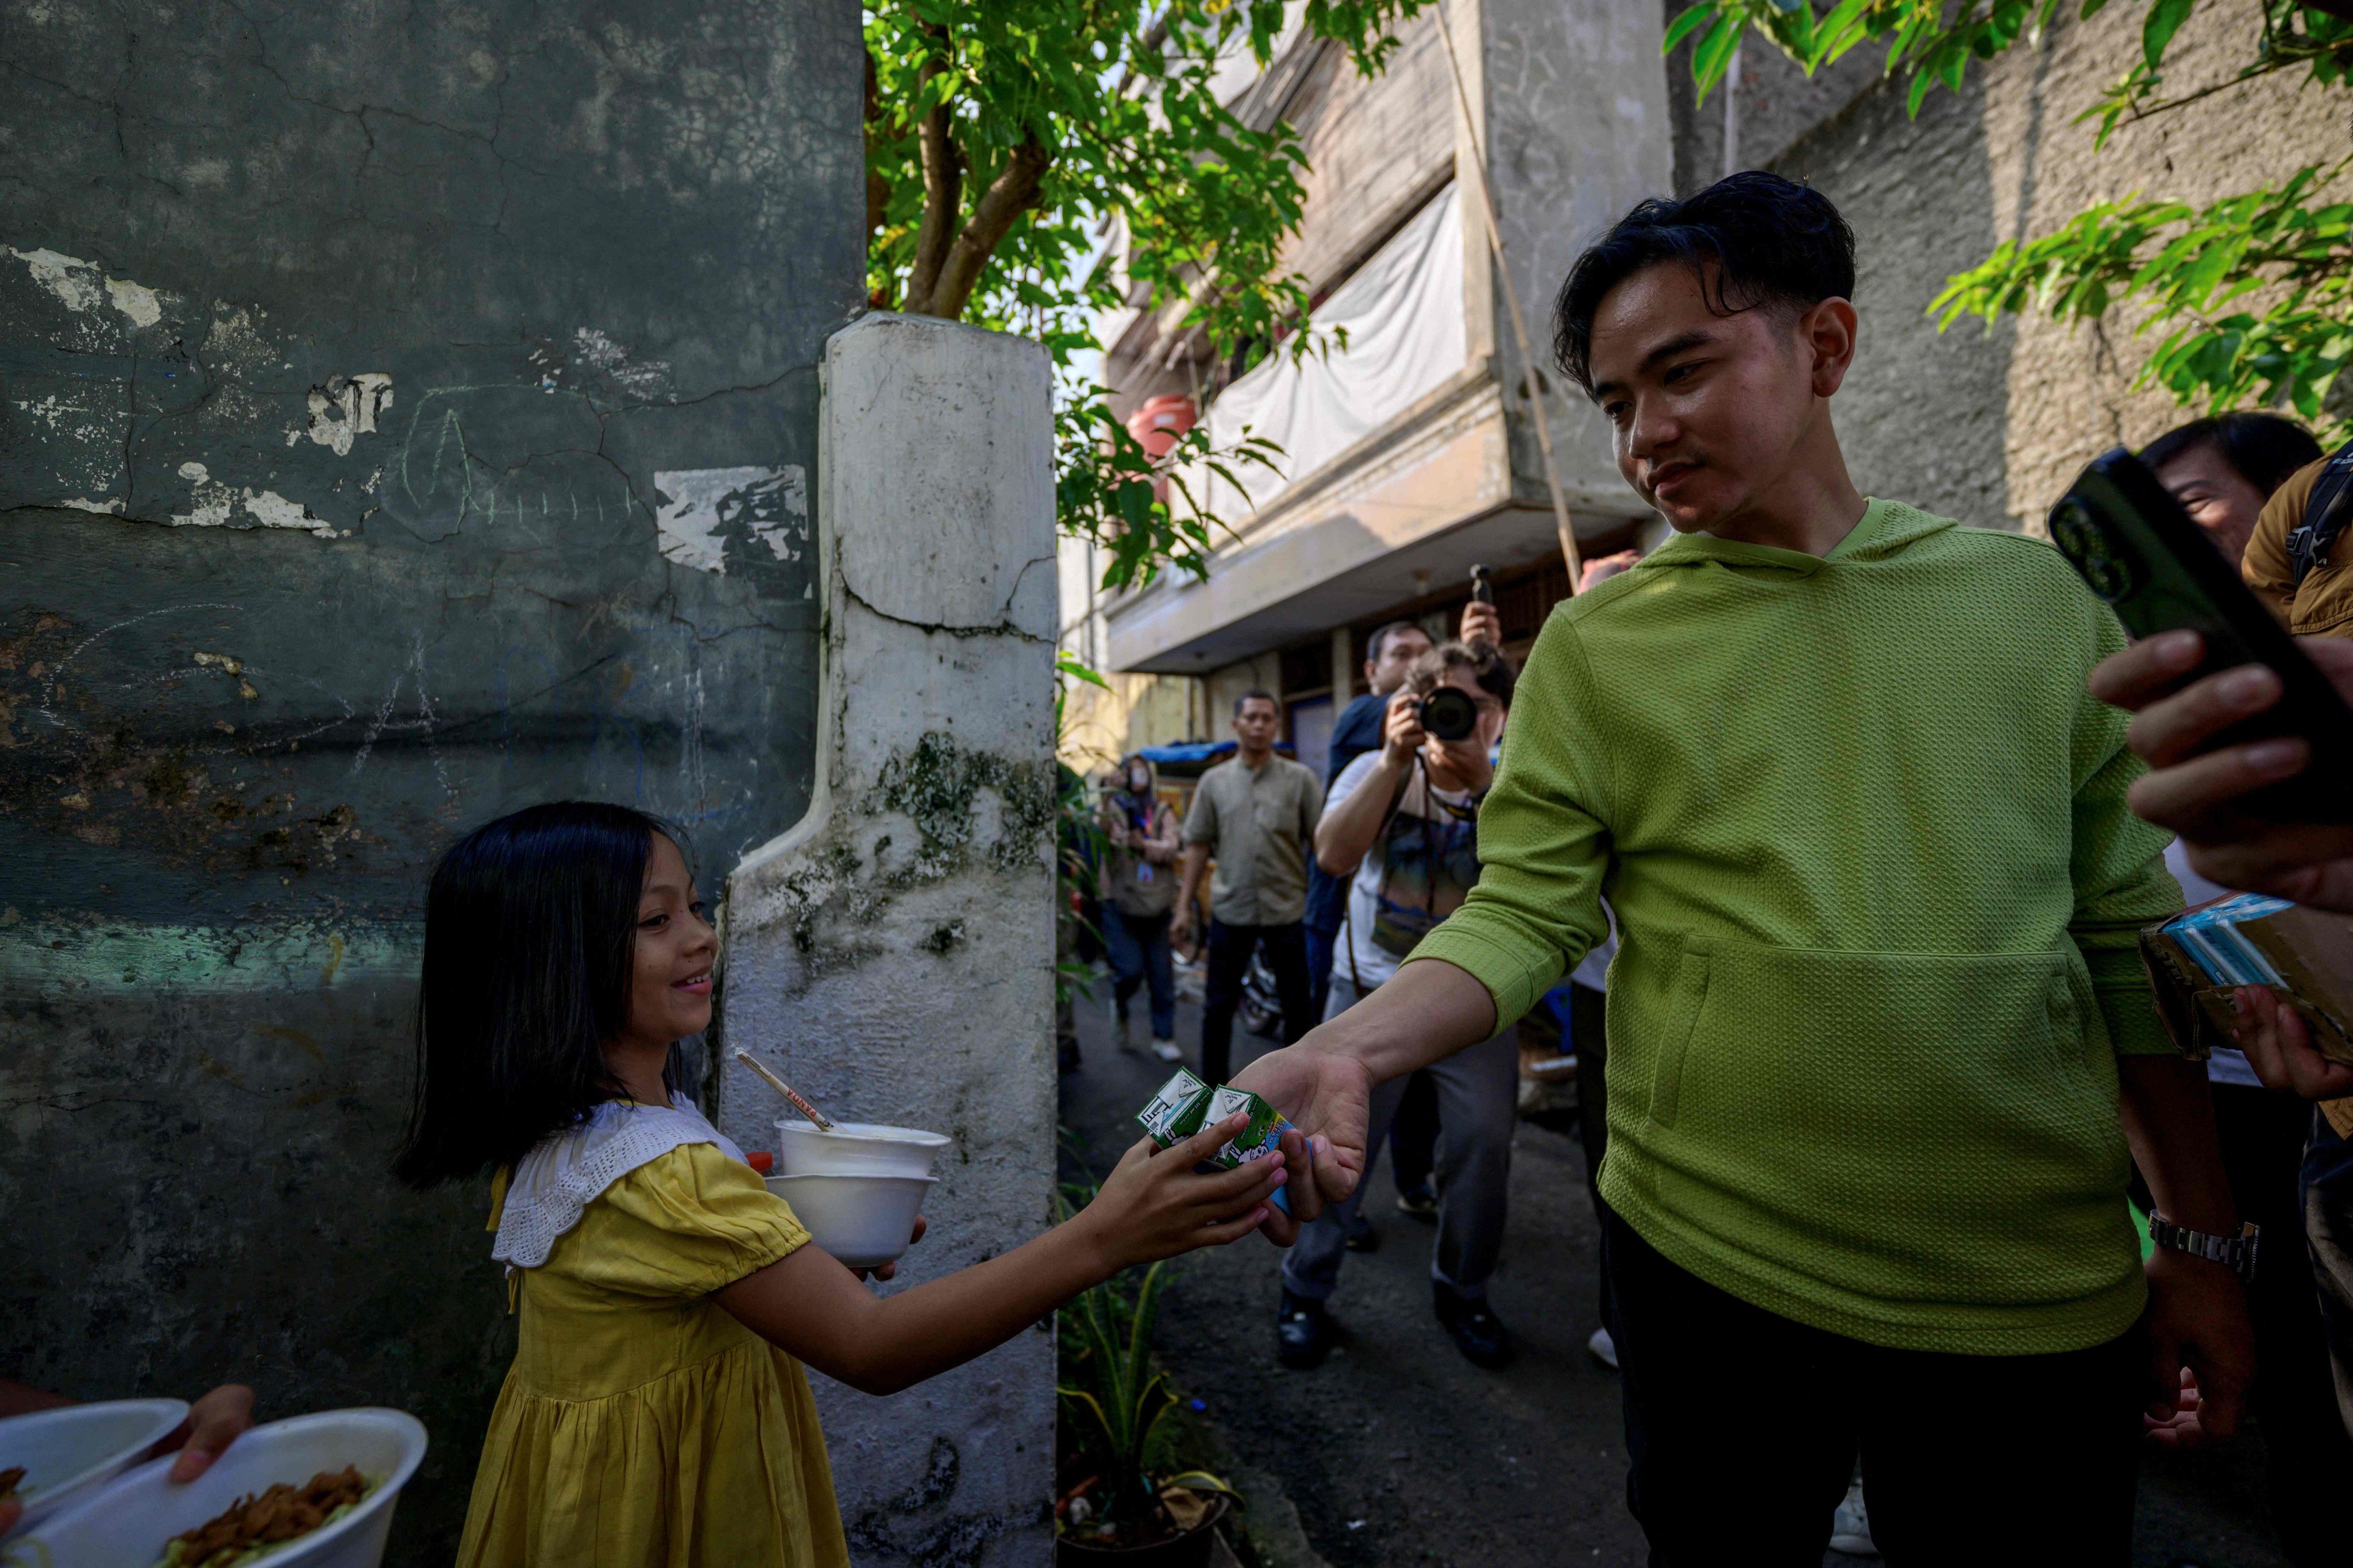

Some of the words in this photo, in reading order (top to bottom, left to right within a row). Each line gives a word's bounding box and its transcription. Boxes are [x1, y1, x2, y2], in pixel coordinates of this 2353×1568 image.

[788, 1088, 816, 1117] PANDA
[1268, 1118, 1282, 1144] CREAM
[1275, 1121, 1285, 1138] FULL
